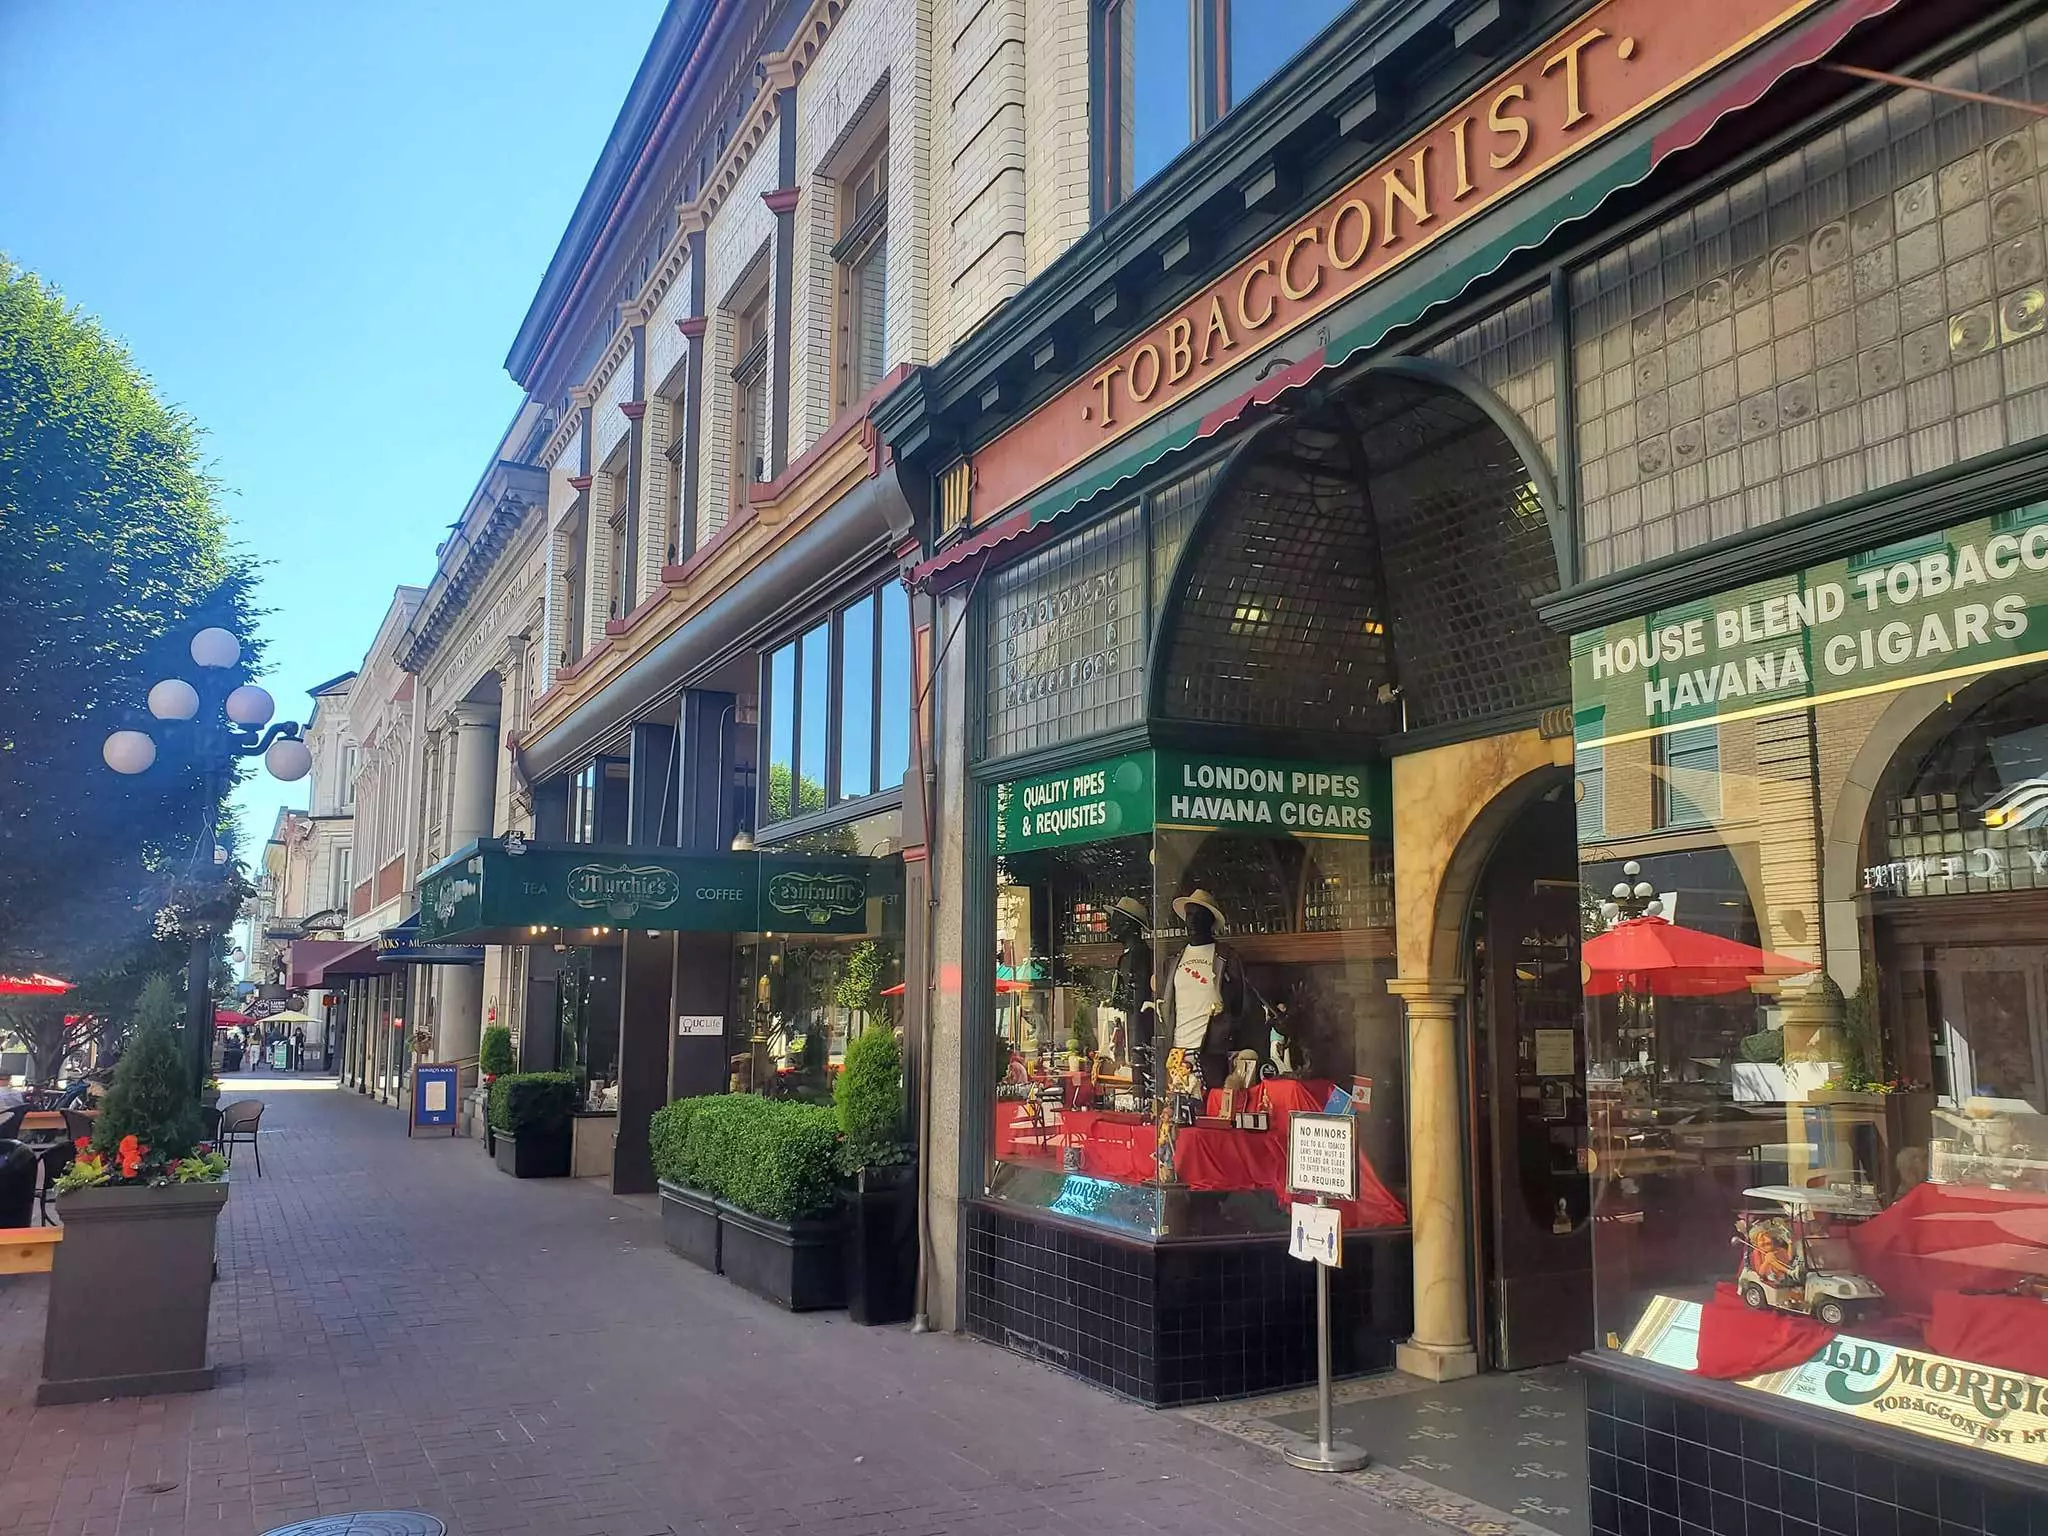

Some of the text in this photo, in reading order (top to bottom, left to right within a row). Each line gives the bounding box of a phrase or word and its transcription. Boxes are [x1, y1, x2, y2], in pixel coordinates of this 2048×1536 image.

[1092, 27, 1611, 430] TOBACCONIST
[1592, 618, 1706, 680] HOUSE
[1716, 582, 1845, 648] BLEND
[1644, 594, 2029, 717] HAVANA CIGARS
[1023, 771, 1105, 812] QUALITY PIPES
[1183, 764, 1360, 798] LONDON PIPES
[1022, 801, 1106, 837] & REQUISITES
[1171, 795, 1372, 829] HAVANA CIGARS
[522, 882, 548, 895] TEA
[579, 874, 667, 896] Murchie's
[696, 888, 743, 900] COFFEE
[1300, 1127, 1347, 1140] NO MINORS
[1308, 1156, 1320, 1164] YEARS
[1321, 1166, 1330, 1174] THIS
[1325, 1150, 1337, 1158] MUST
[1312, 1175, 1345, 1187] REQUIRED
[1808, 1340, 1881, 1376] LD
[1873, 1397, 2013, 1444] TOBACCONIST
